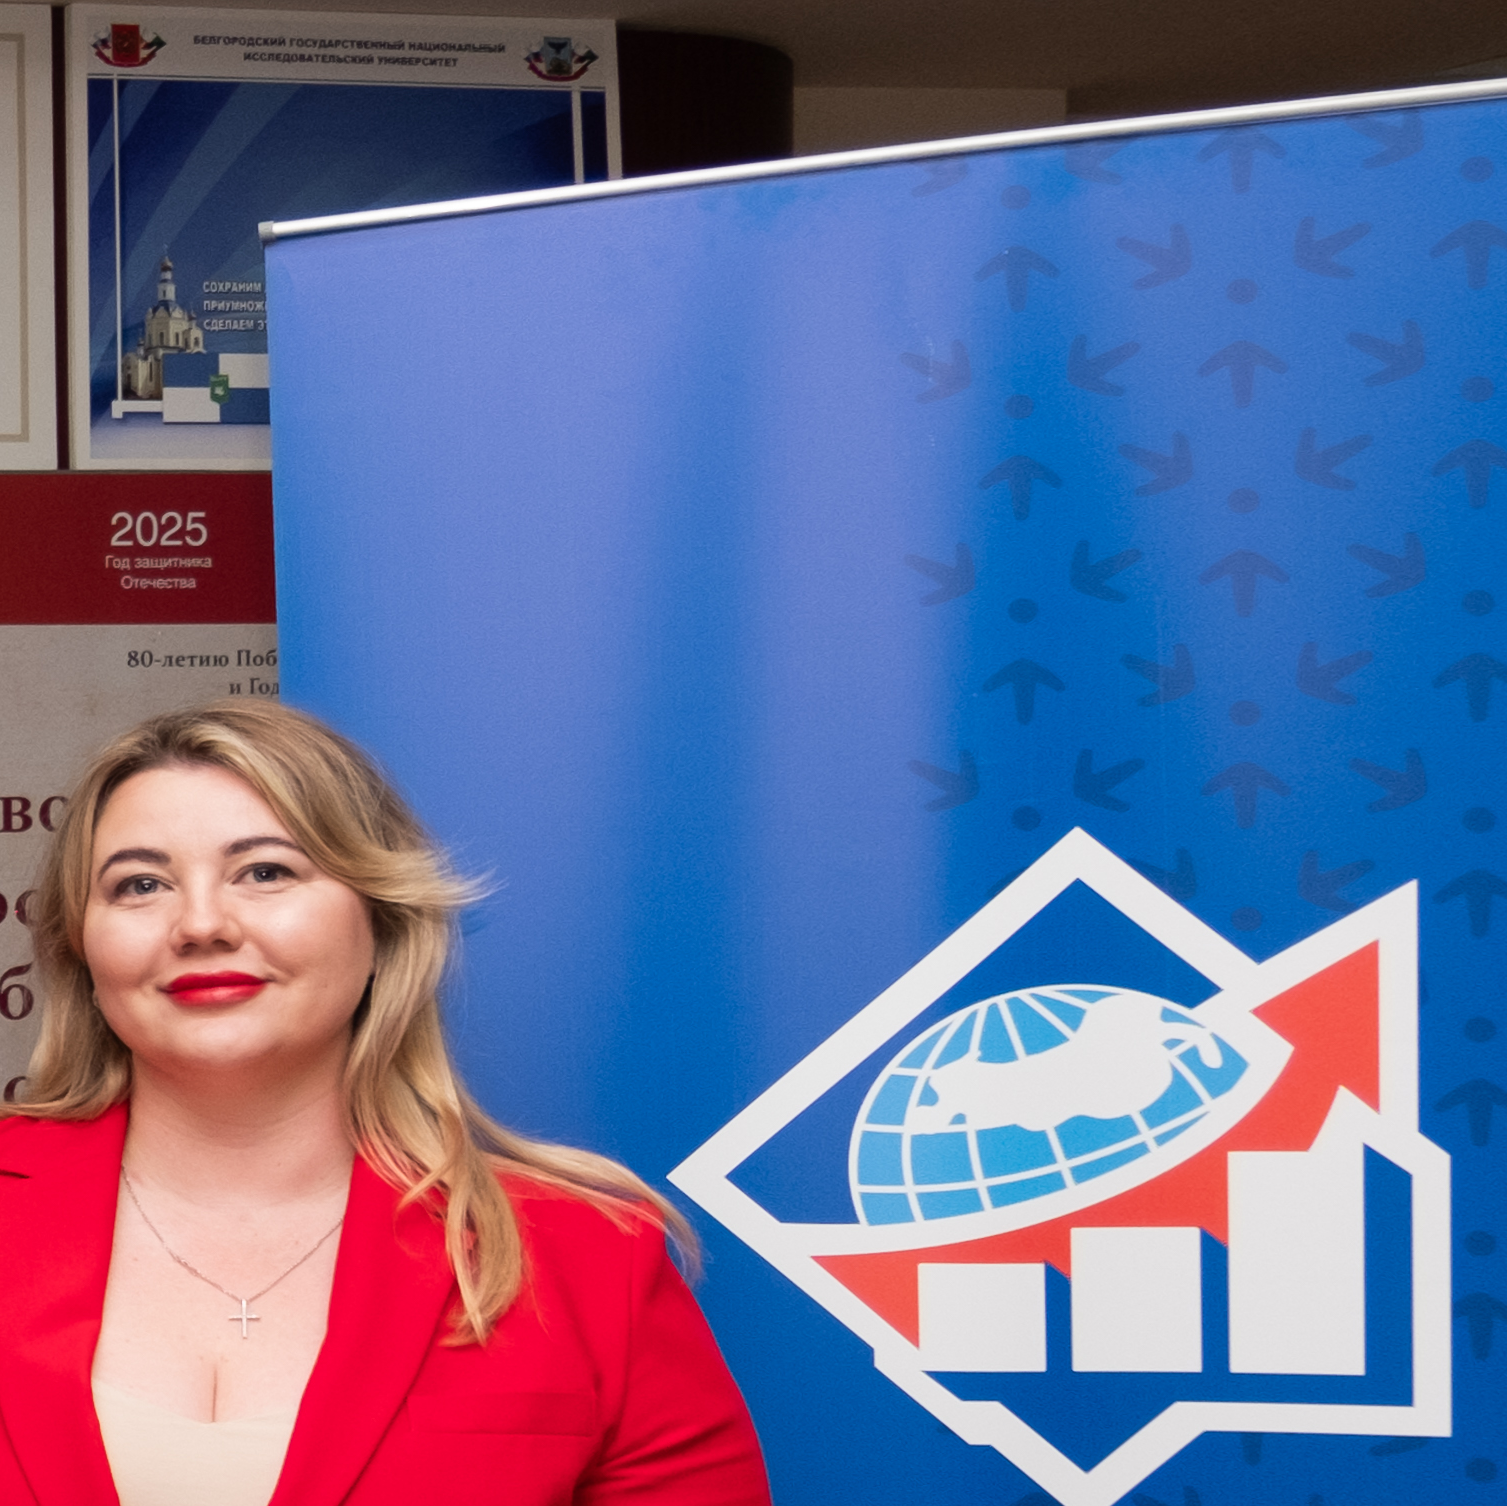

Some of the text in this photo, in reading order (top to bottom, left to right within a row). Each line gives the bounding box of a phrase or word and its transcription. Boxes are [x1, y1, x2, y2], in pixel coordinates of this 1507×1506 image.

[193, 35, 286, 47] БЕЛГОРОДСКИЙ
[204, 301, 266, 311] ПРИУМНОЖ
[110, 512, 208, 547] 2025
[105, 555, 213, 570] Год защитника
[121, 575, 196, 589] Отечества
[127, 650, 229, 668] 80-летию
[229, 683, 241, 694] и
